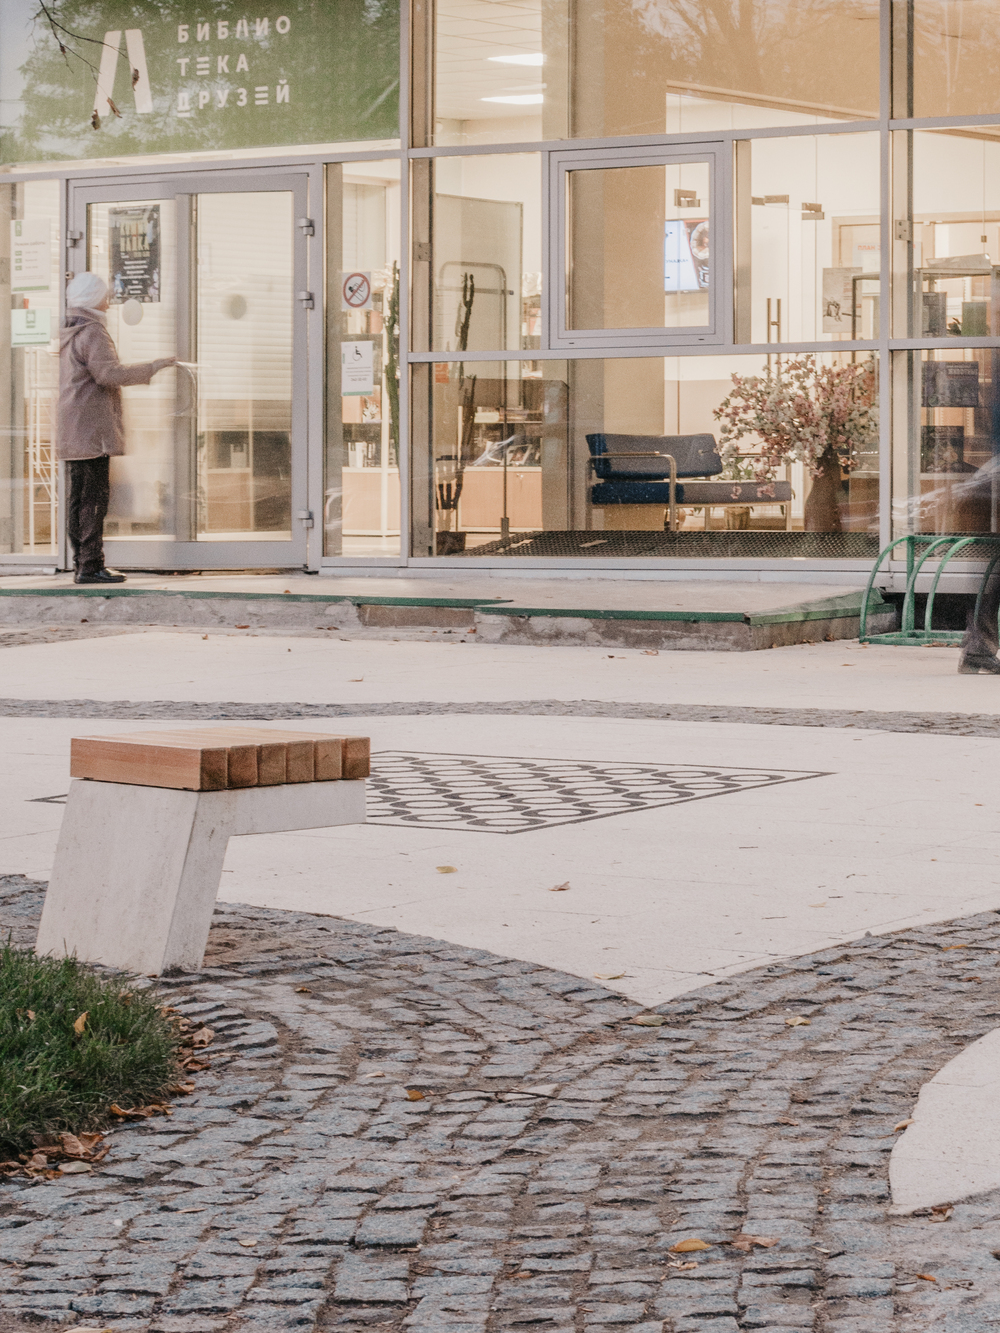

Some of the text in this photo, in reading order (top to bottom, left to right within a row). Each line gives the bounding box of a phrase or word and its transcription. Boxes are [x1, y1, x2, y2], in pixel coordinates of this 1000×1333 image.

[178, 16, 291, 43] БИБЛИО
[176, 53, 249, 76] ТЕКА
[177, 79, 290, 117] ДРУЗЕЙ
